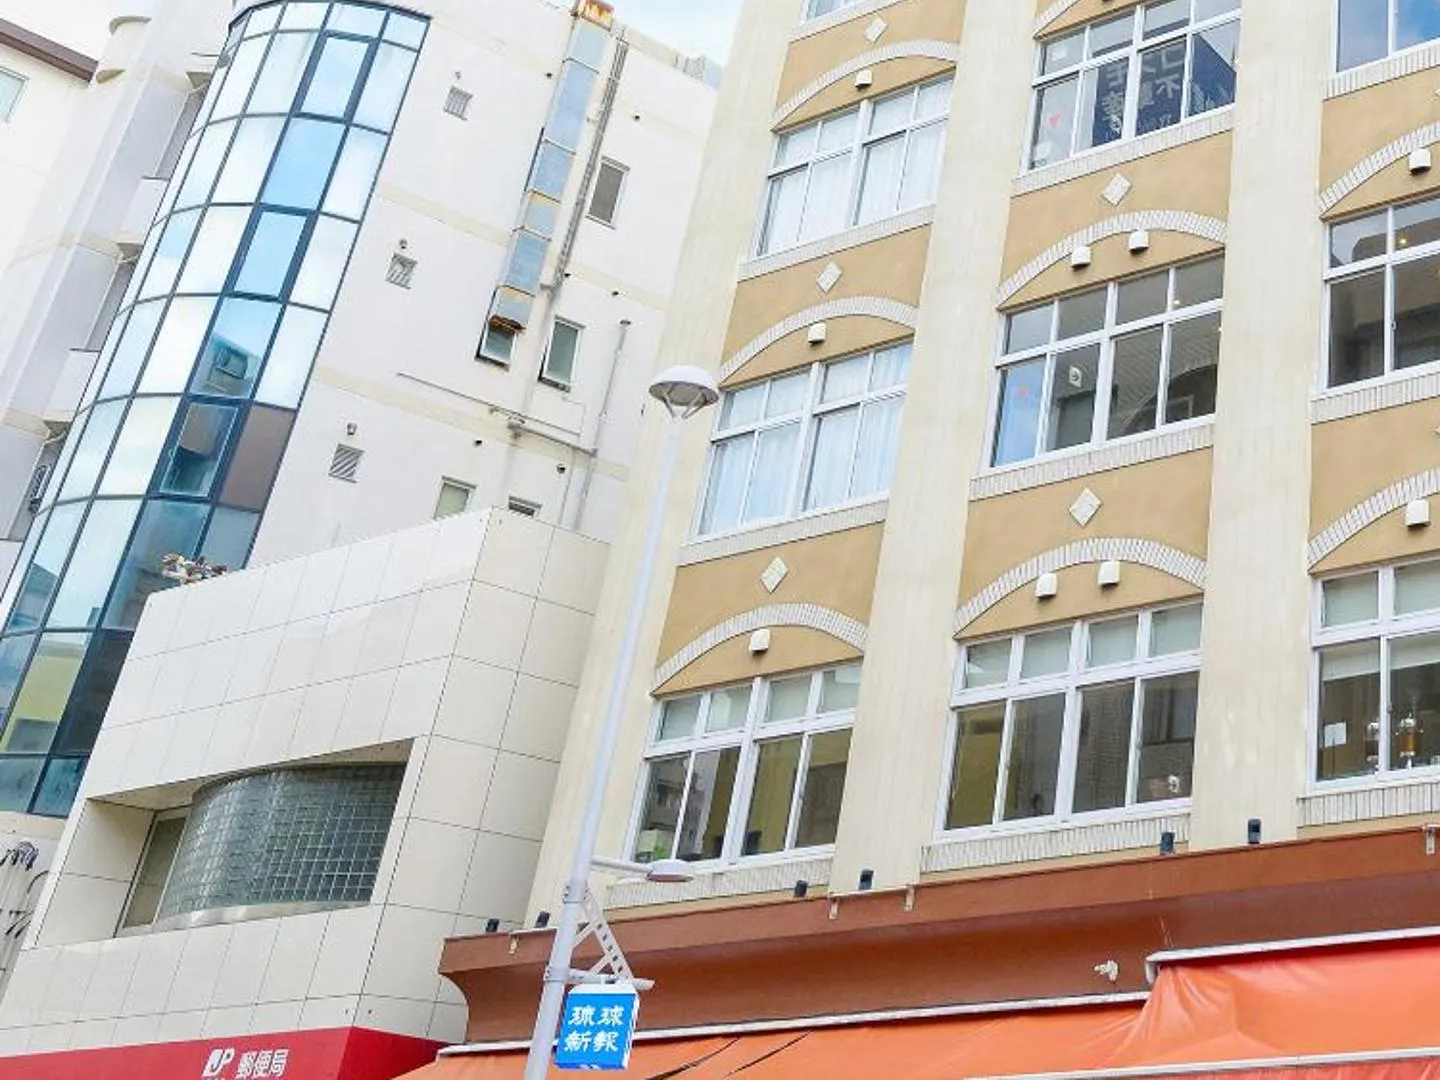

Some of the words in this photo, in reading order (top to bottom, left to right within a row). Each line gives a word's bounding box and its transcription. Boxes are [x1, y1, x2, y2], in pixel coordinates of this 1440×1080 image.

[568, 1005, 625, 1027] 琉球
[563, 1029, 620, 1053] 新報
[203, 1047, 236, 1077] JP
[236, 1048, 290, 1080] 郵便局
